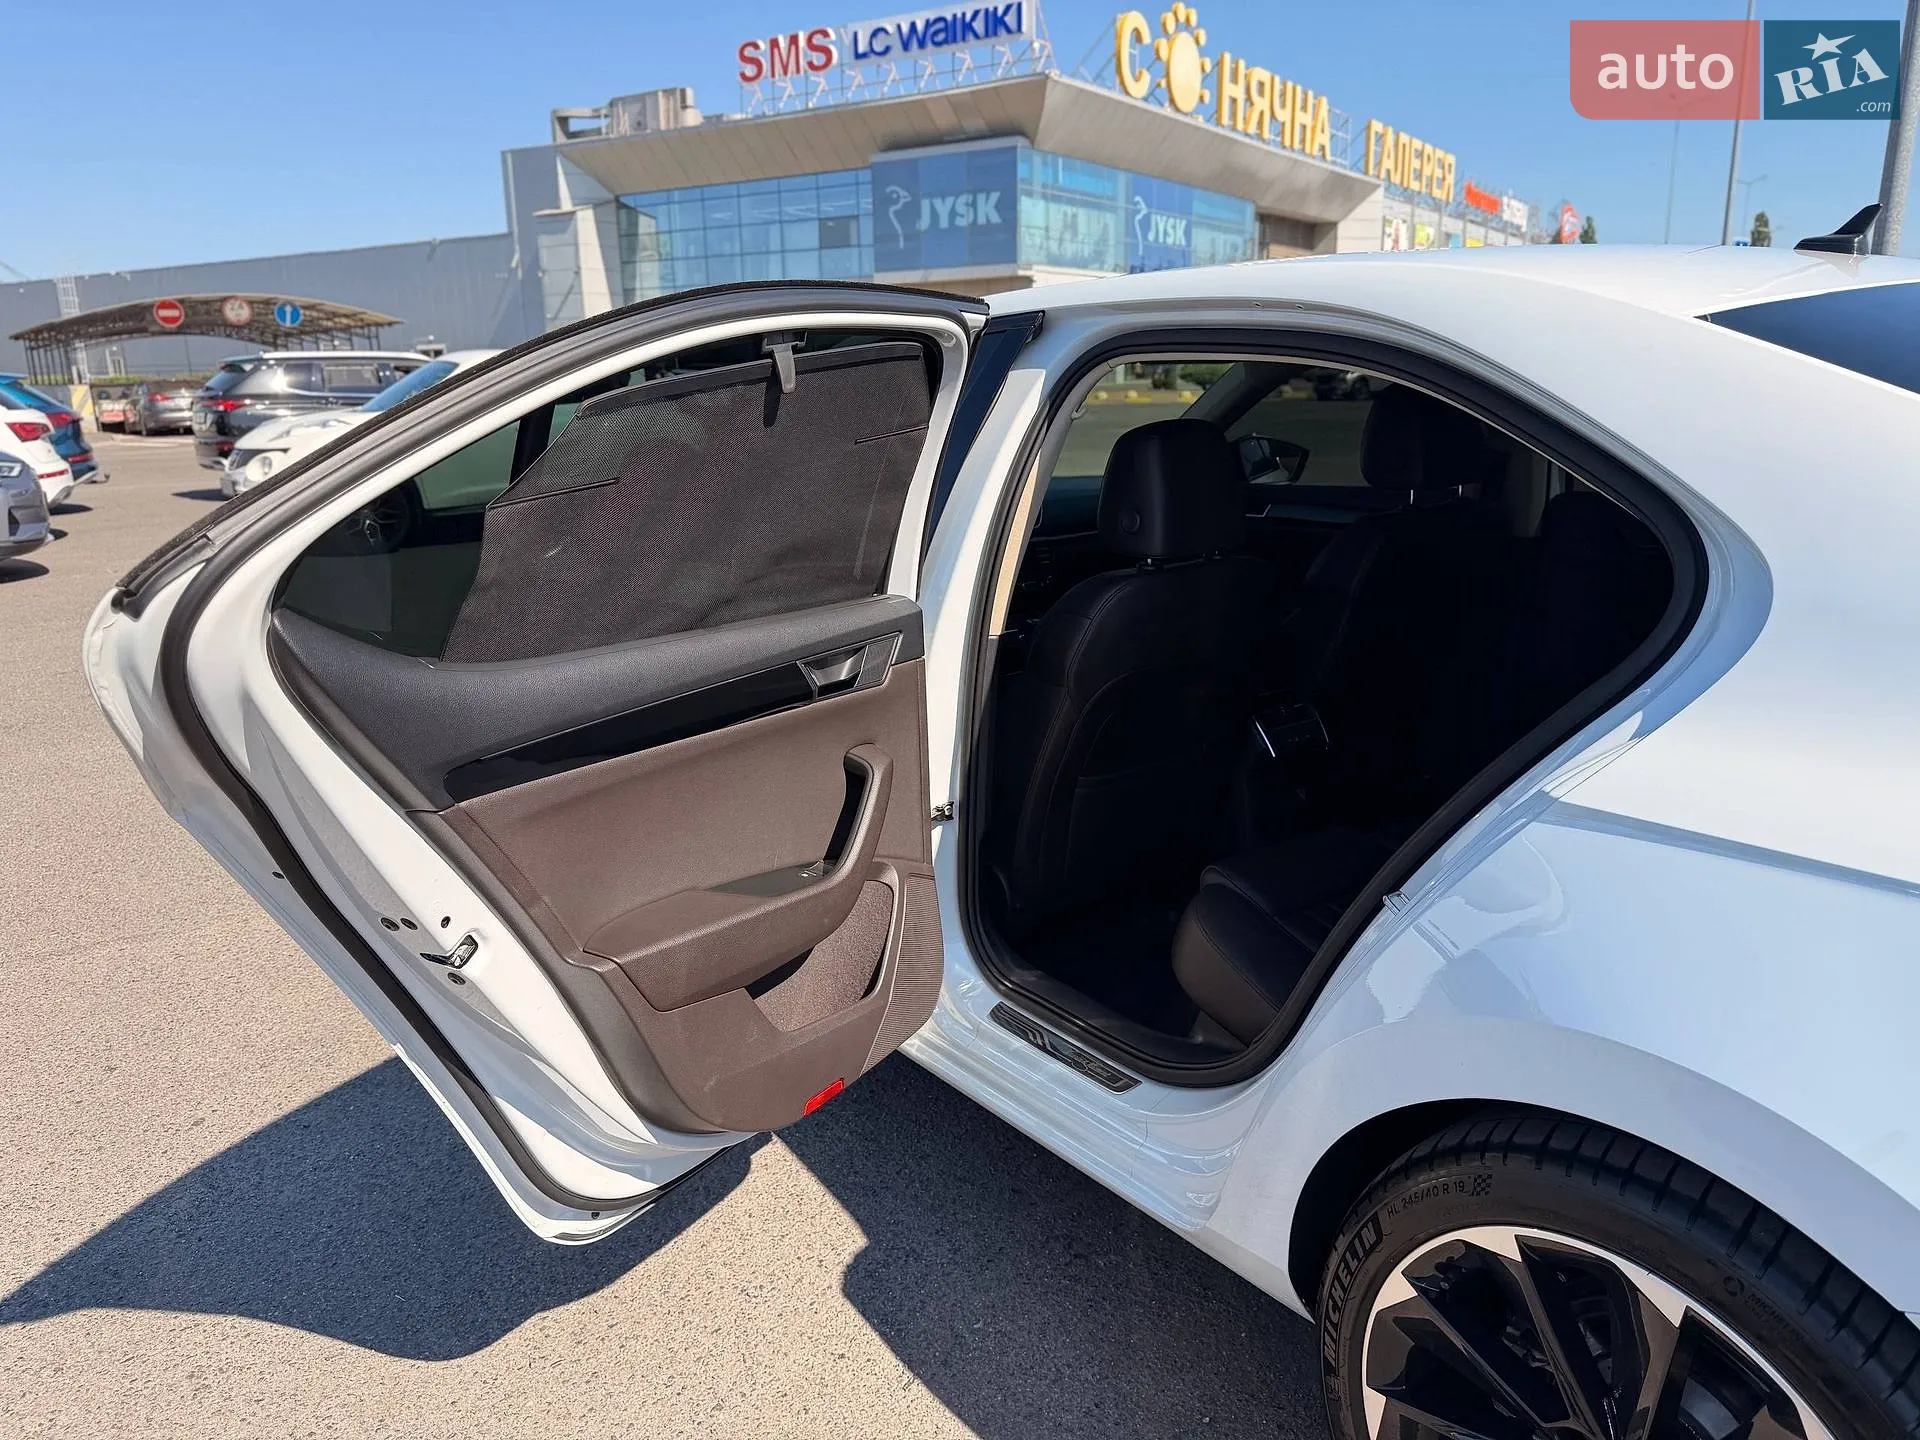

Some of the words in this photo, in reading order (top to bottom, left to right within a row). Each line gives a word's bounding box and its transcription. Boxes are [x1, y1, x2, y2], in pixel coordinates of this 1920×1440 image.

[738, 28, 834, 83] SMS
[853, 27, 892, 60] LC
[1366, 118, 1456, 202] ГАЛЕРЕЯ
[915, 191, 1002, 231] JYSK
[1148, 213, 1187, 246] JYSK
[1442, 1183, 1450, 1195] R
[1454, 1180, 1465, 1193] 19
[1324, 1221, 1377, 1369] MICHELIN
